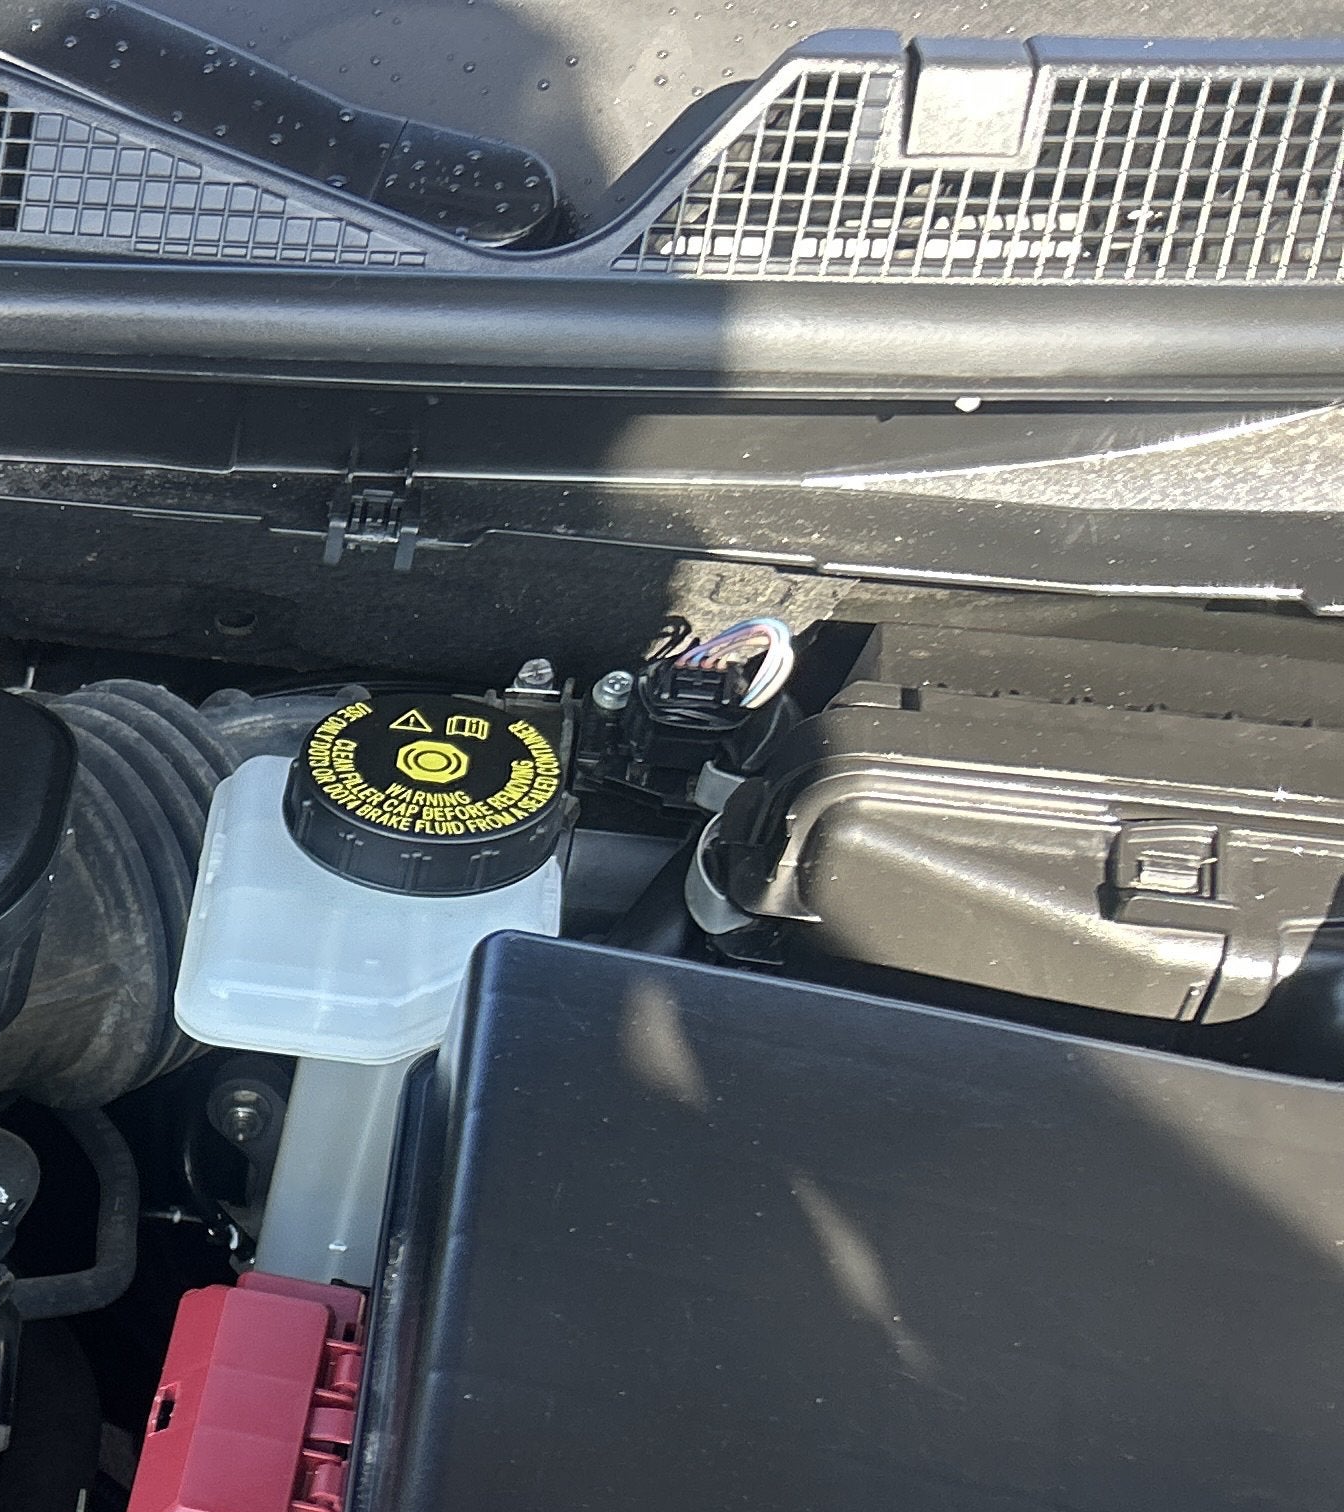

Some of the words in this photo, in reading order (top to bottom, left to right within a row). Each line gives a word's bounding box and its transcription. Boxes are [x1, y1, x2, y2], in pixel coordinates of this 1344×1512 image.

[337, 702, 373, 722] USE
[314, 717, 347, 742] ONLY
[308, 741, 331, 766] DOT3
[332, 740, 357, 771] CLEAN
[508, 720, 560, 775] CONTAINER
[312, 768, 336, 784] OR
[487, 761, 534, 810] REMOVING
[323, 784, 362, 810] DOT4
[339, 773, 385, 805] FILLER
[386, 783, 470, 805] WARNING
[518, 777, 558, 812] SEALED
[355, 803, 411, 832] BRAKE
[383, 797, 419, 817] CAP
[422, 800, 490, 821] BEFORE
[510, 808, 529, 820] A
[414, 820, 466, 835] FLUID
[466, 812, 516, 833] FROM
